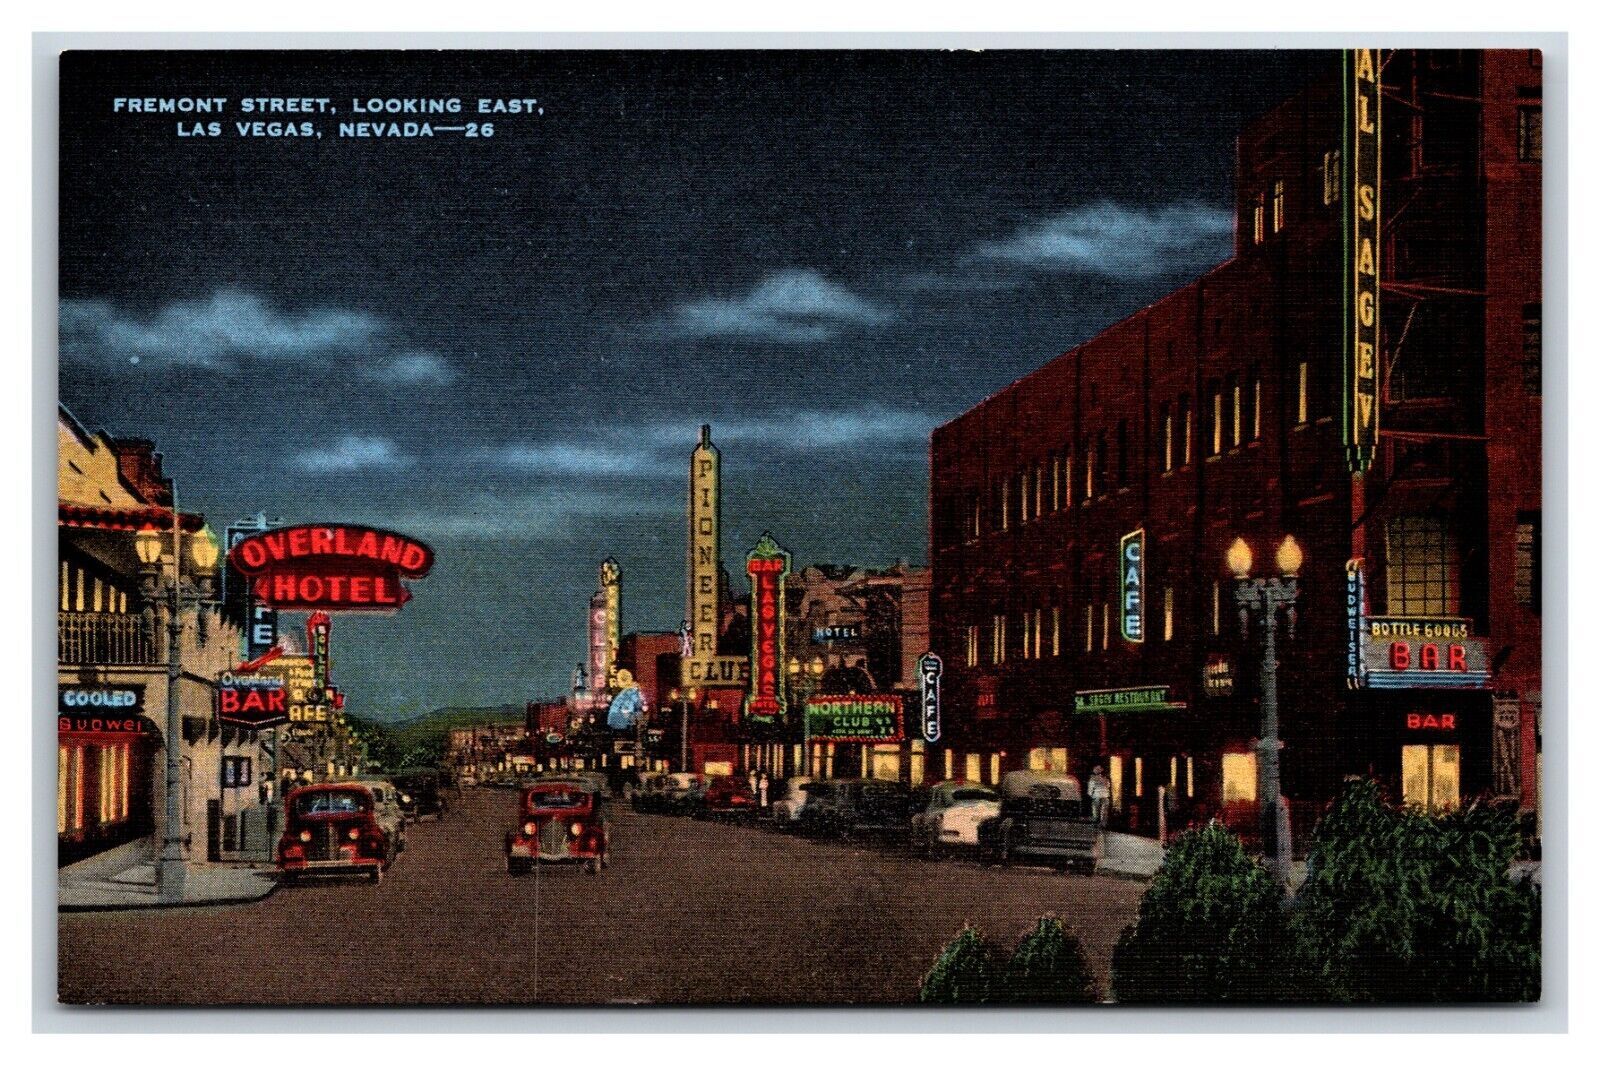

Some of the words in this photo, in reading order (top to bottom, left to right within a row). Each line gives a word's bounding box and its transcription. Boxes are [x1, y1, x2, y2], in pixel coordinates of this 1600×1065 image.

[1359, 184, 1376, 428] SAGEV
[242, 528, 427, 570] OVERLAND
[699, 459, 713, 652] PIONEER
[273, 574, 397, 604] HOTEL
[761, 576, 775, 620] LAS
[1125, 542, 1142, 636] CAFE
[816, 627, 858, 638] HOTEL
[1347, 571, 1358, 677] BUDWEISER
[1371, 621, 1421, 637] BOTTLE
[761, 622, 775, 697] VEGAS
[1390, 641, 1468, 672] BAR
[63, 690, 137, 707] COOLED
[221, 688, 286, 713] BAR
[289, 704, 326, 721] AFE
[808, 699, 896, 716] NORTHERN
[925, 671, 937, 736] CAFE
[832, 716, 870, 728] CLUB
[1406, 713, 1456, 729] BAR
